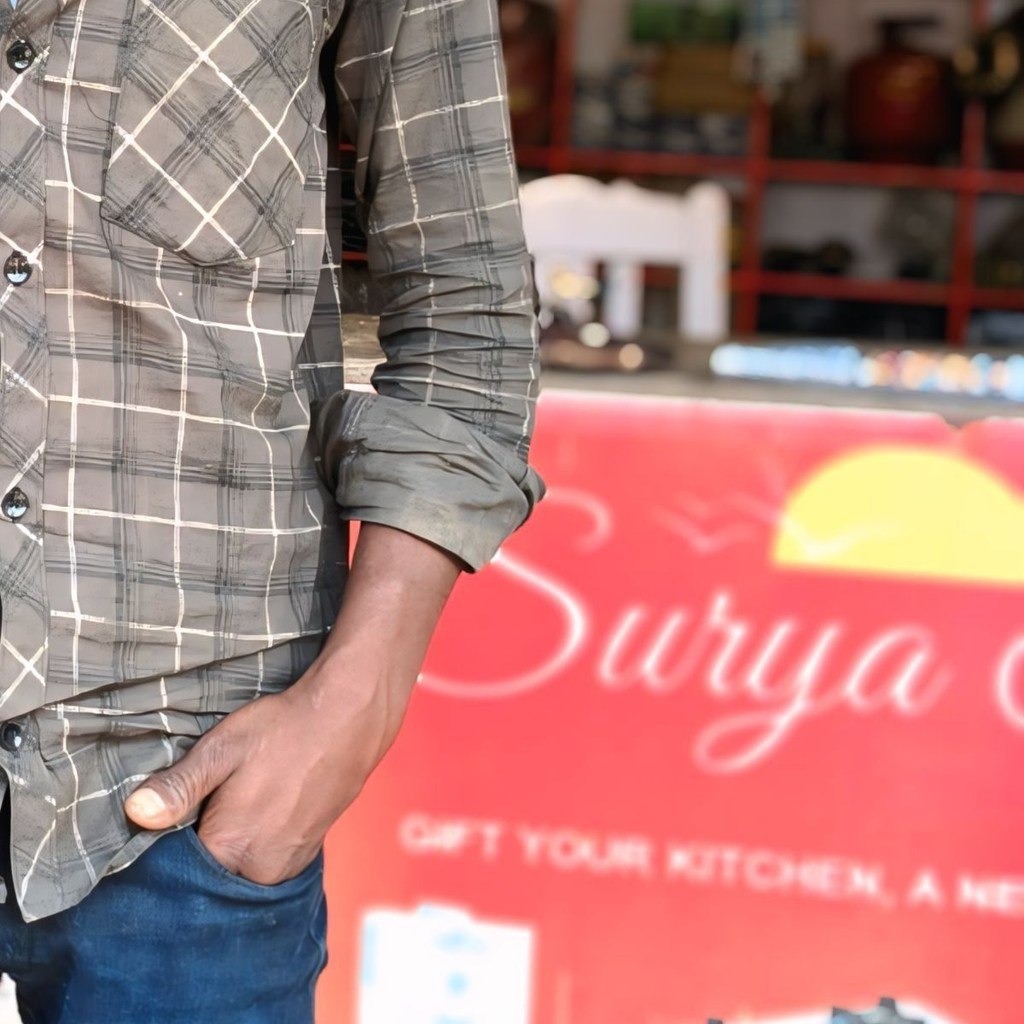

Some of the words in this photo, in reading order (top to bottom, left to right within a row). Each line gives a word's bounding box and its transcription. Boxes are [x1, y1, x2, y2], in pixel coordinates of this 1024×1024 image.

[417, 486, 954, 775] Surya
[400, 815, 502, 862] GIFT
[516, 825, 653, 878] YOUR
[907, 866, 944, 910] A
